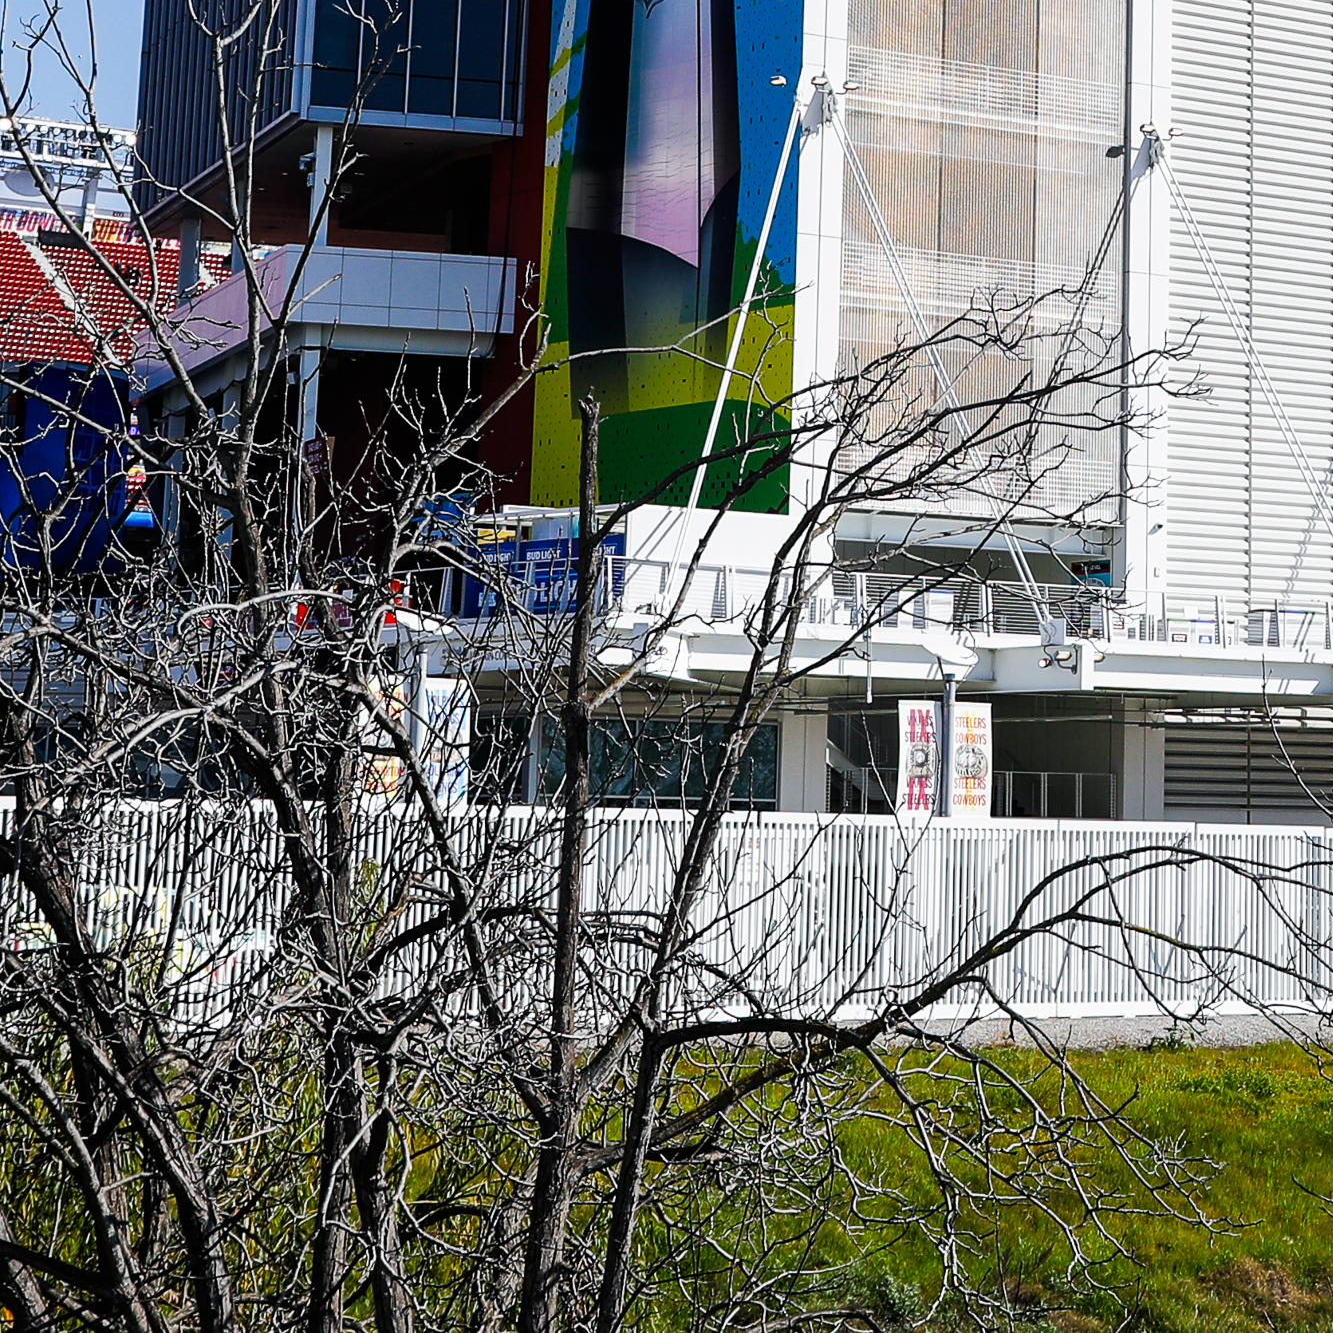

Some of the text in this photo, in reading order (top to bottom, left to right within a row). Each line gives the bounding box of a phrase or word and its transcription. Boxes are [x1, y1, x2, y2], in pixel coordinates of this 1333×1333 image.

[526, 550, 540, 561] BUD
[955, 717, 987, 729] STEELERS
[955, 733, 988, 745] COWBOYS
[954, 777, 987, 790] STEELERS
[952, 794, 987, 806] COWBOYS
